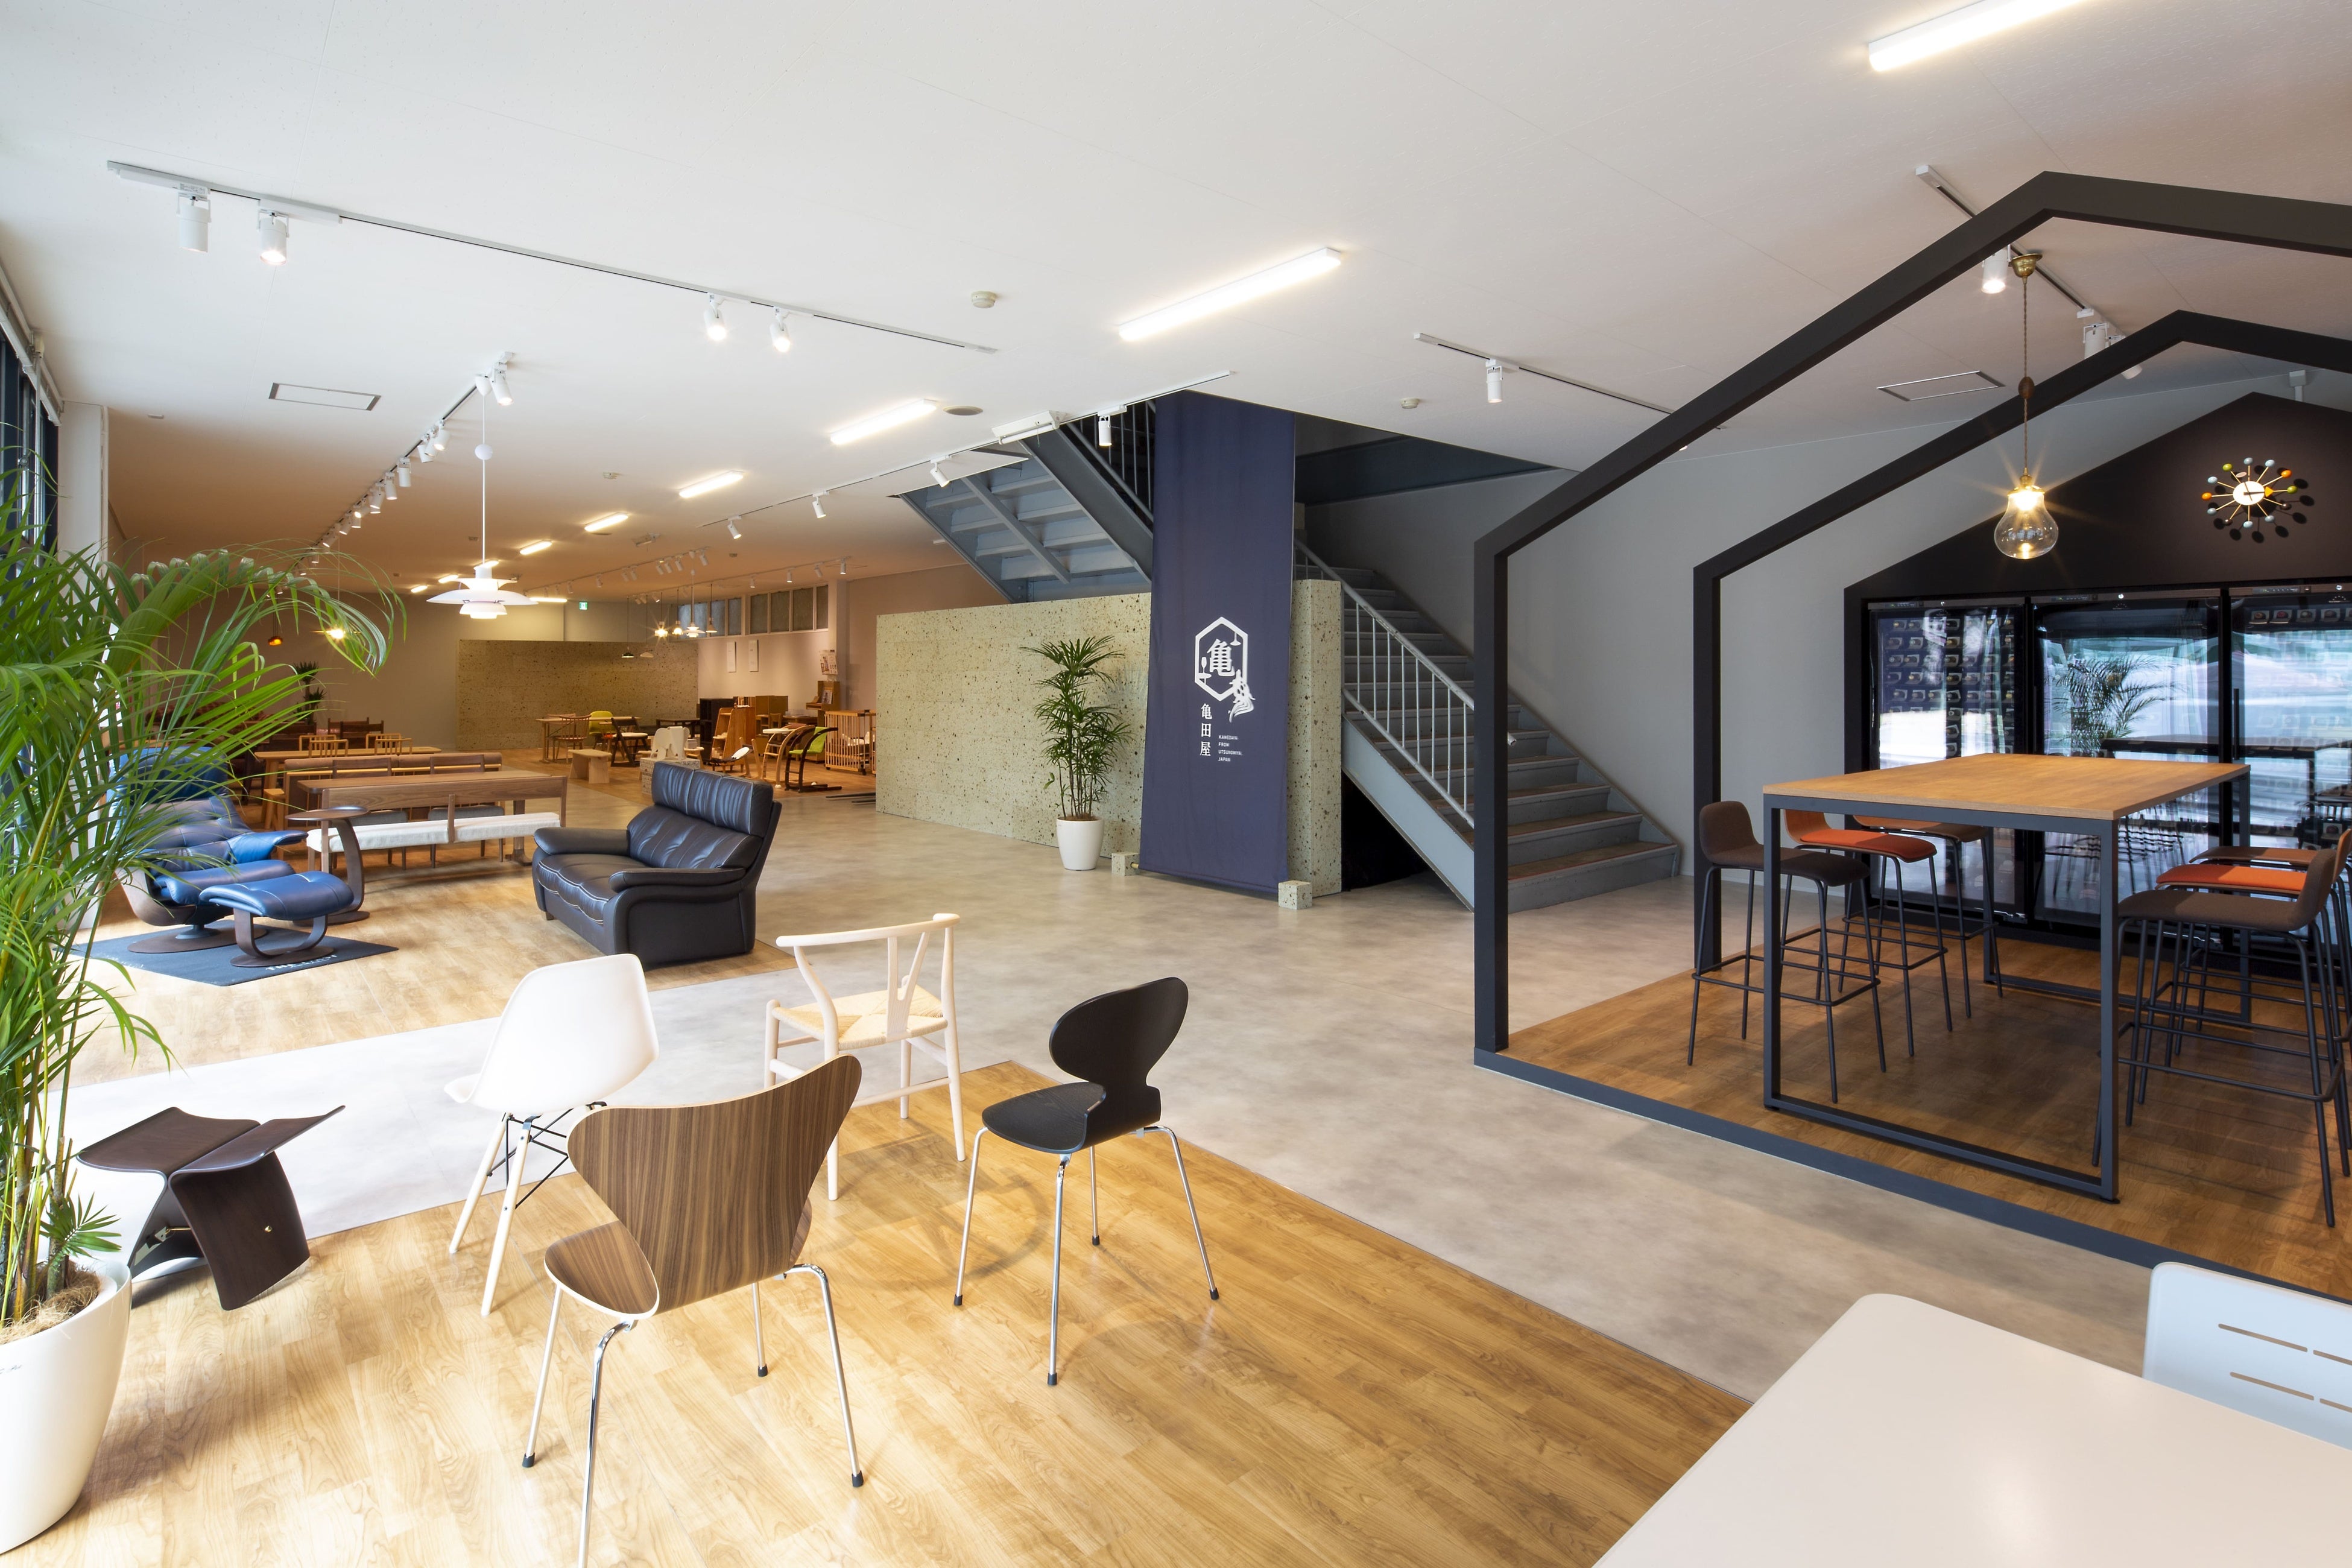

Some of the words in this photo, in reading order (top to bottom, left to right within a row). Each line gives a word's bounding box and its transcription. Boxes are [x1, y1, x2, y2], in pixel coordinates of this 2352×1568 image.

[1207, 639, 1235, 677] 亀
[1200, 703, 1212, 756] 亀田屋
